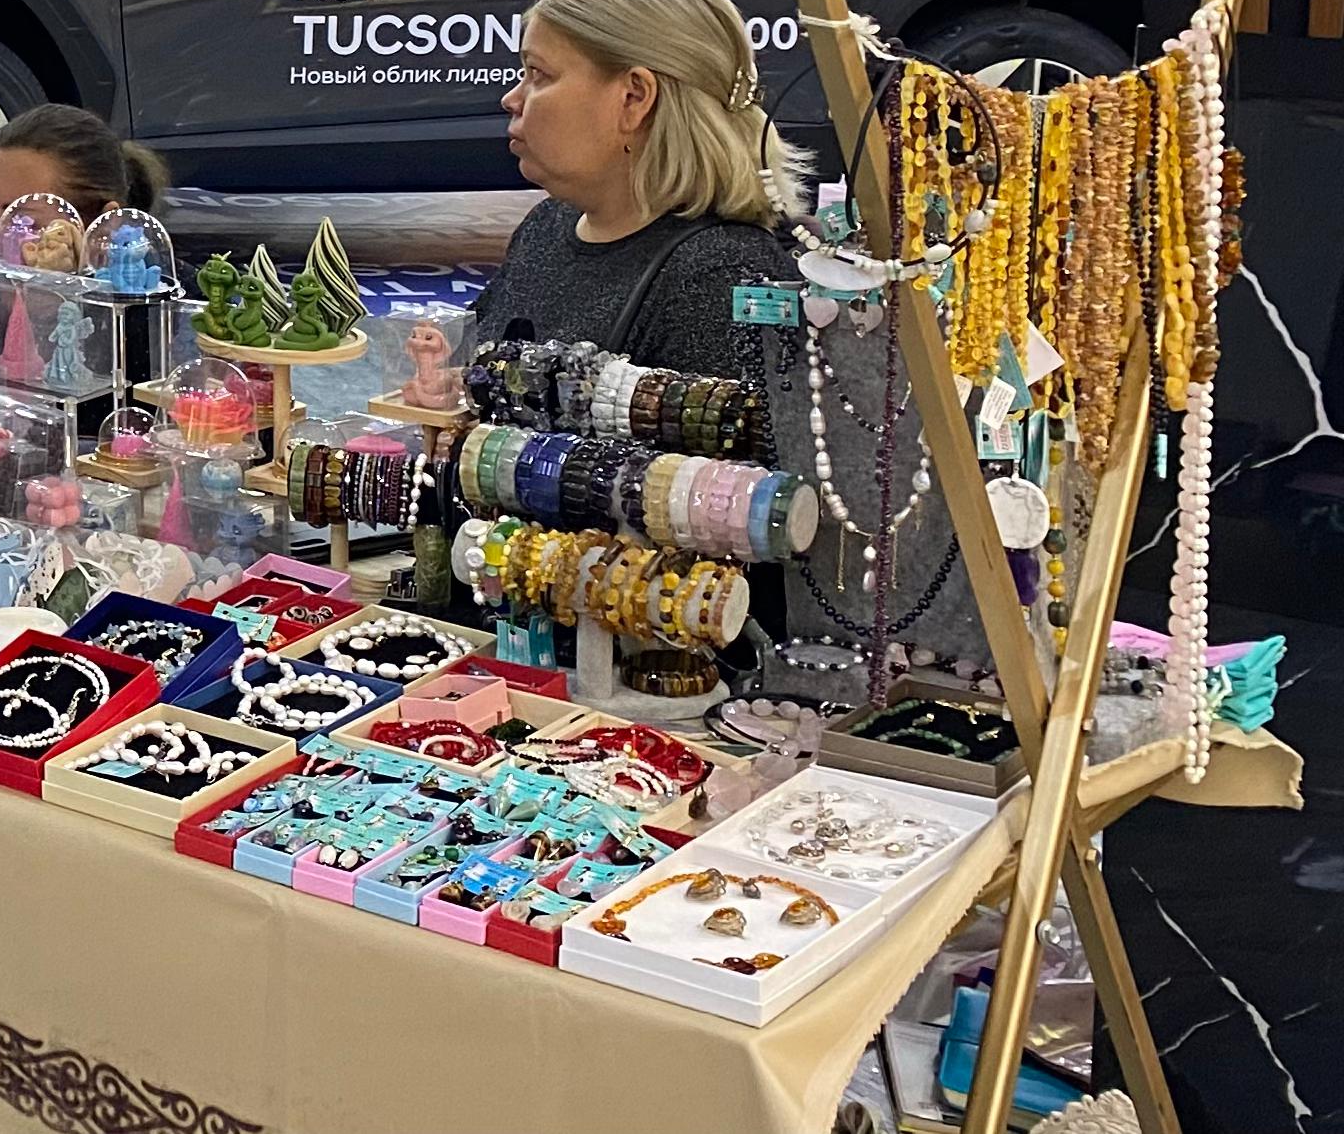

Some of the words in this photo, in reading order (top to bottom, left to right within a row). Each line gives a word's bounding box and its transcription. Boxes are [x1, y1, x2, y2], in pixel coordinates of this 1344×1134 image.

[293, 13, 522, 56] TUCSON
[743, 16, 799, 51] 00
[289, 66, 367, 85] Новый
[372, 65, 442, 84] облик
